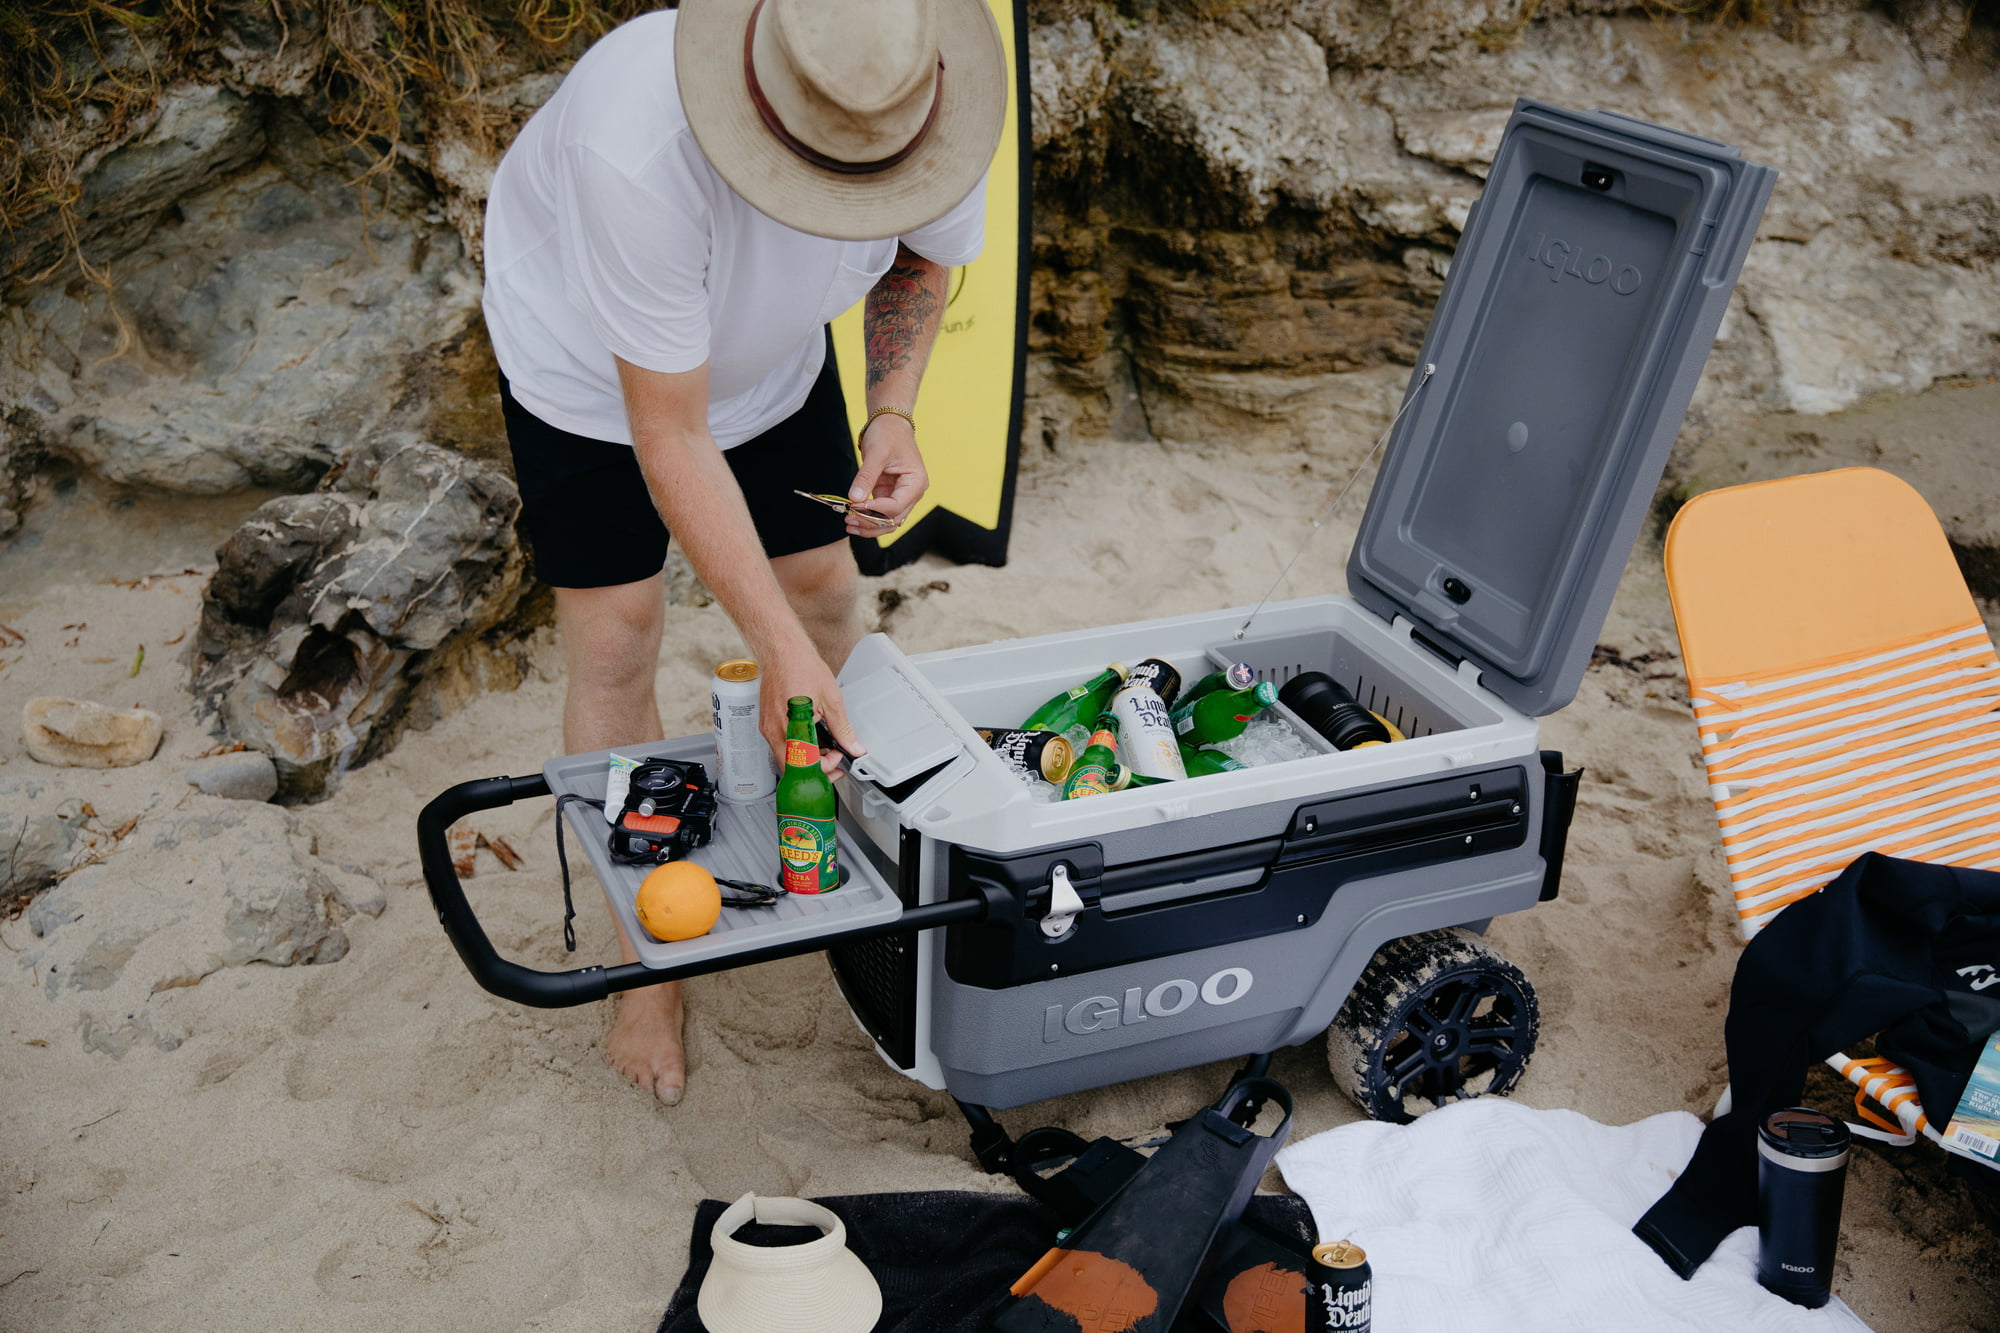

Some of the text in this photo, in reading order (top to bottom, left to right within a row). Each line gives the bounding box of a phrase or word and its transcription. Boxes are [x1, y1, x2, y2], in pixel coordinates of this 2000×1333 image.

[1528, 232, 1642, 296] IGLOO
[780, 846, 820, 862] REED'S
[1043, 967, 1254, 1044] IGLOO
[1781, 1262, 1815, 1273] IGLOO
[1321, 1279, 1371, 1312] Liquid
[1325, 1302, 1371, 1328] Death
